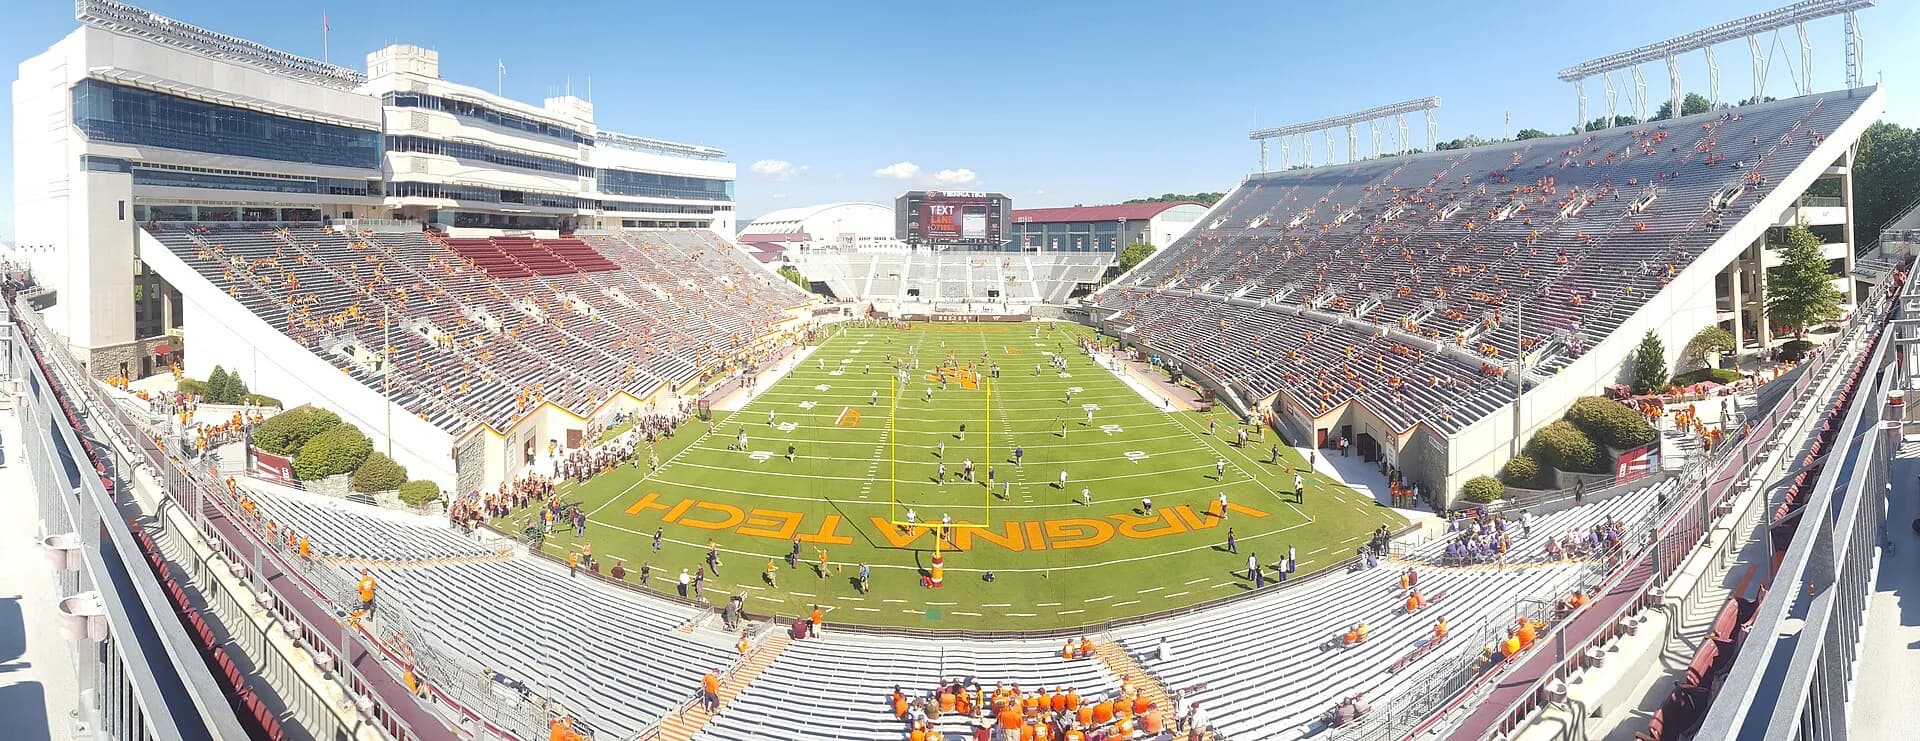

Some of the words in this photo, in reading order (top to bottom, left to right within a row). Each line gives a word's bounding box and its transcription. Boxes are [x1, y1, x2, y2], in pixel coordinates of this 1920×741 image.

[929, 205, 955, 215] TEXT
[624, 491, 855, 545] TECH
[869, 498, 1271, 552] VIRGINIA
